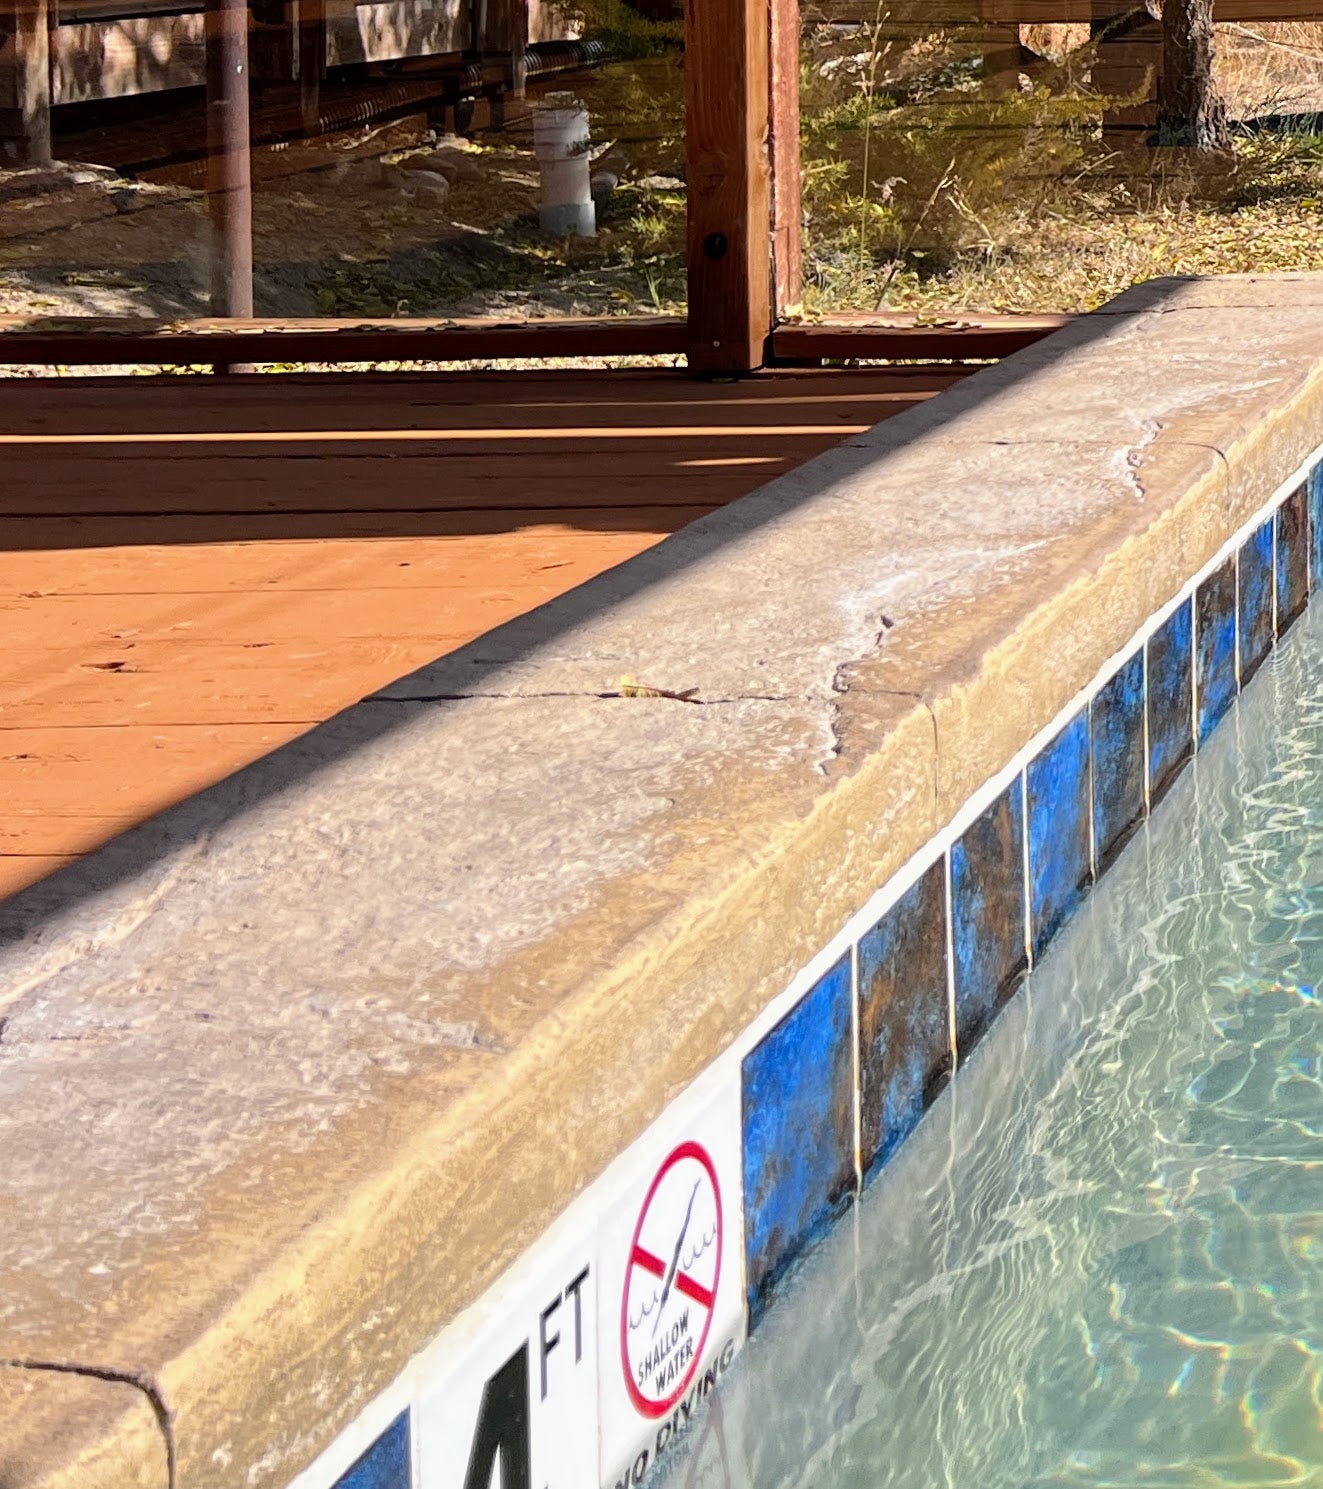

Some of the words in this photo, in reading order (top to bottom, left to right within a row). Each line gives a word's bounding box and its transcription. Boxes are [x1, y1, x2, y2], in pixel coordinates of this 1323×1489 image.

[538, 1260, 591, 1403] FT
[637, 1305, 690, 1387] SHALLOW
[655, 1335, 694, 1396] WATER
[655, 1337, 735, 1456] DIVING
